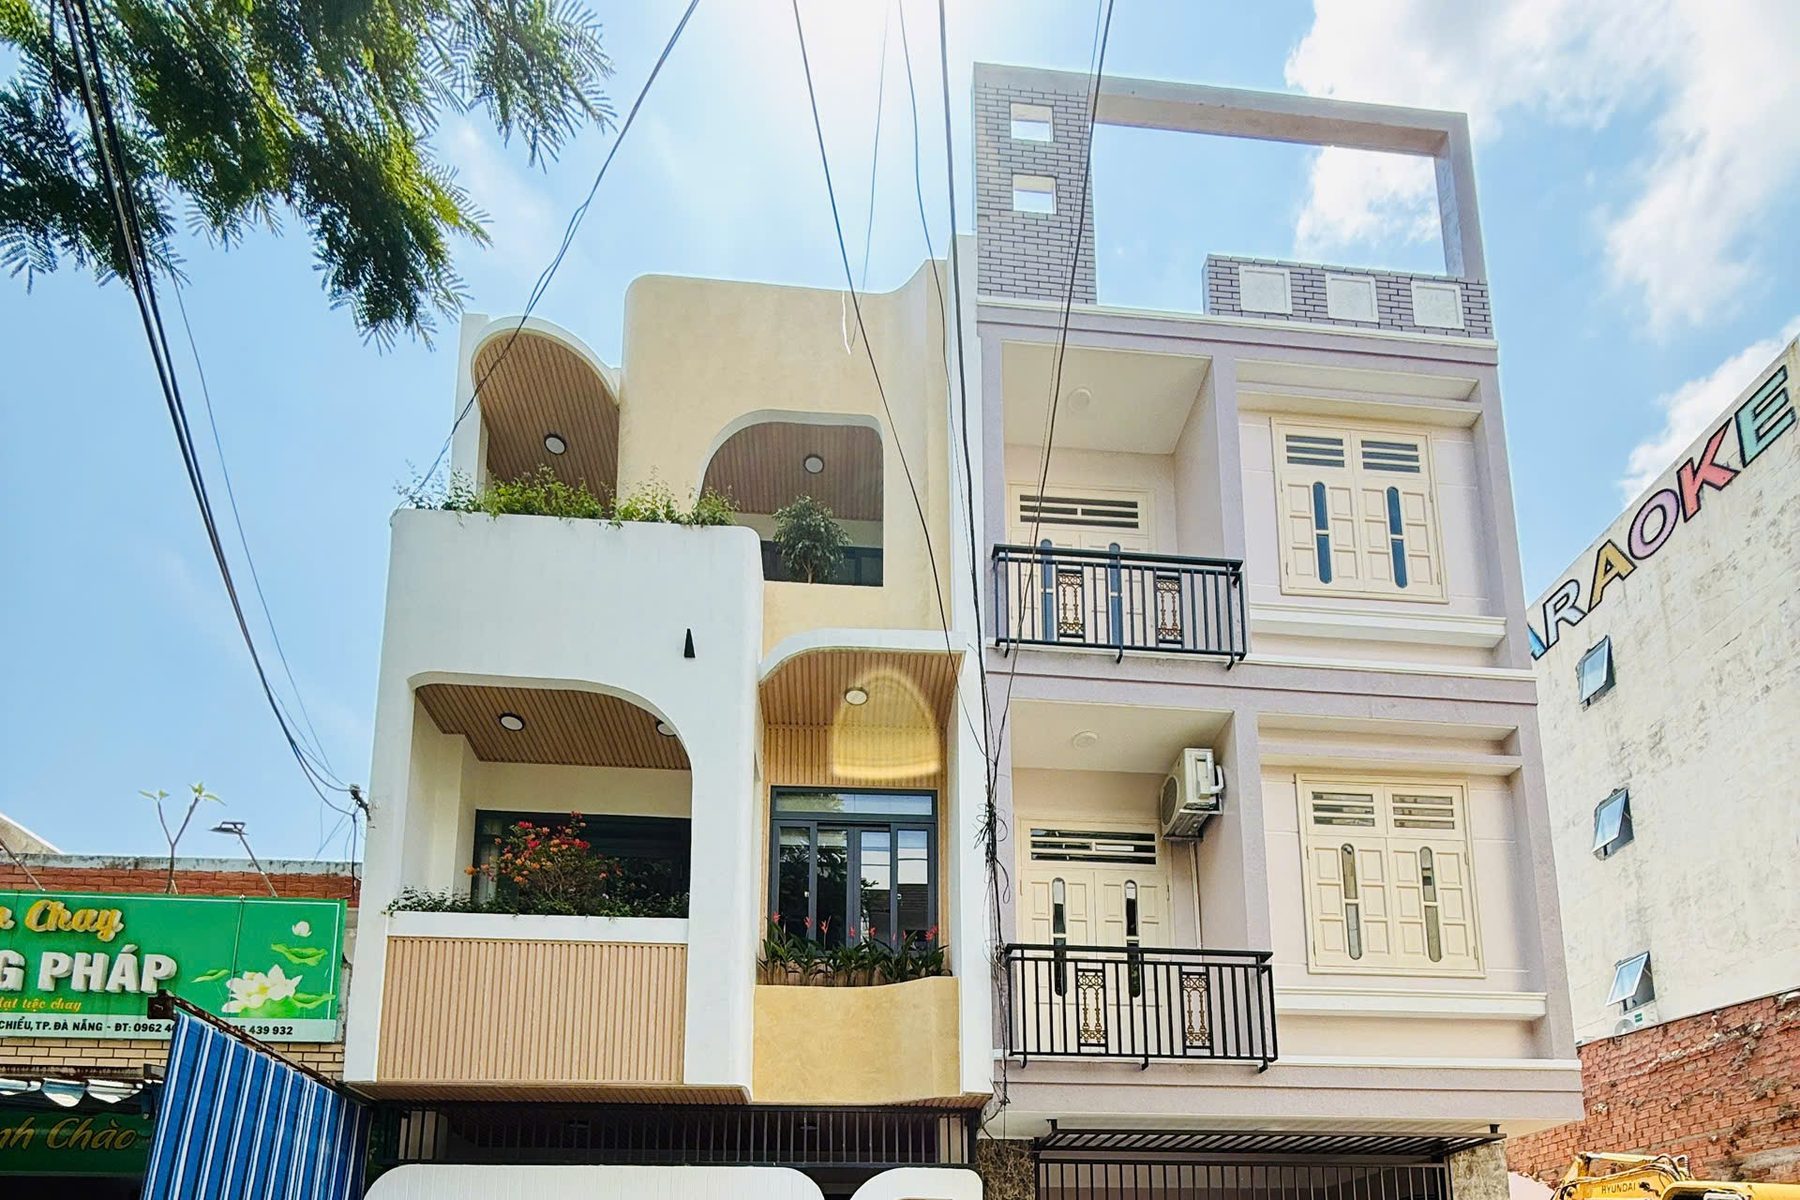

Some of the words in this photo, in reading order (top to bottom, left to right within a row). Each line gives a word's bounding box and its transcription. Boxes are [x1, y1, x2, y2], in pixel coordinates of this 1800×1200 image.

[25, 899, 125, 943] Chay
[37, 944, 178, 994] PHÁP
[50, 998, 82, 1012] chay
[35, 1021, 51, 1030] TP.
[53, 1019, 69, 1031] ĐÀ
[114, 1022, 132, 1033] ĐT:
[133, 1022, 162, 1033] 0962
[248, 1025, 270, 1035] 439
[272, 1025, 293, 1036] 932
[47, 1117, 137, 1151] Chào
[1601, 1182, 1636, 1195] HYUNDAI
